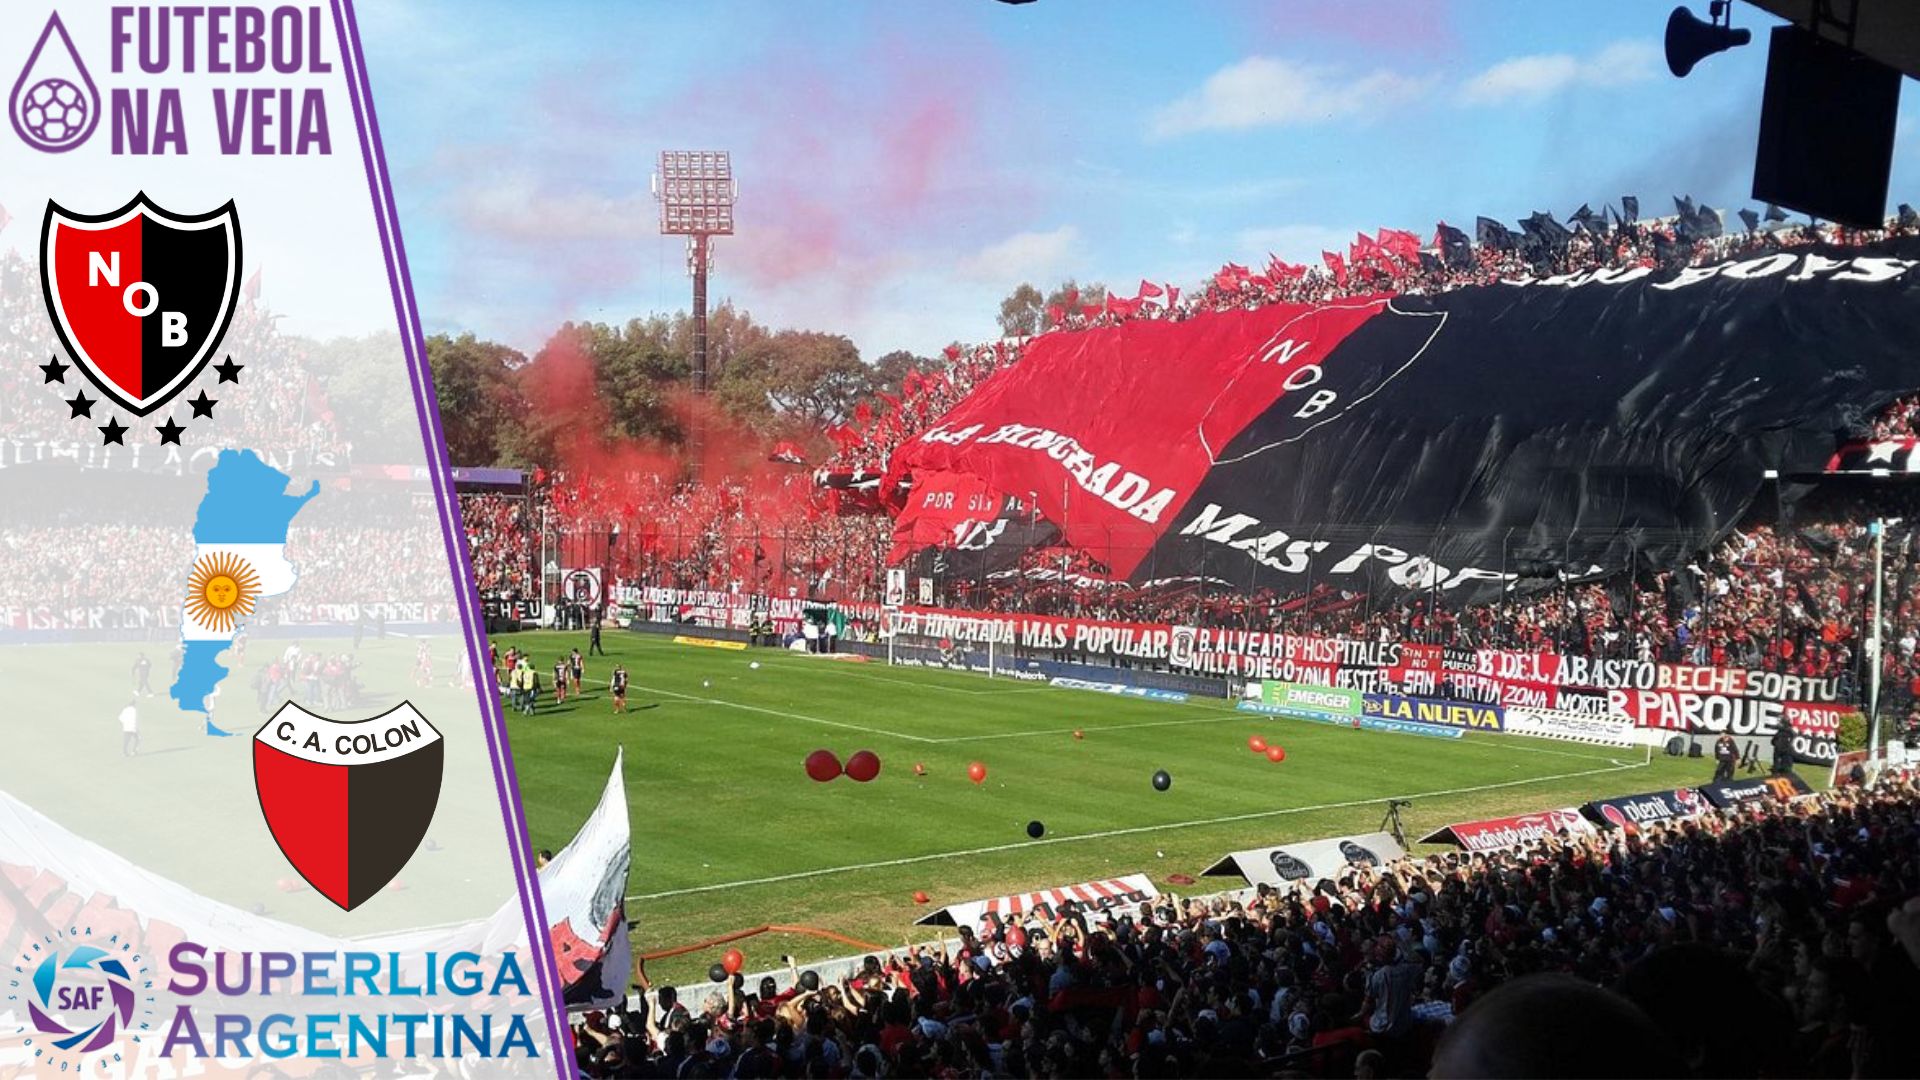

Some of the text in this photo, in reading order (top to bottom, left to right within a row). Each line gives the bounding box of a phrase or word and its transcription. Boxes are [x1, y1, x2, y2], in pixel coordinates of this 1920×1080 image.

[922, 490, 954, 511] POR
[1180, 503, 1330, 573] MAS
[924, 613, 1015, 644] HINCHADA
[1021, 620, 1067, 649] MAS
[1073, 624, 1168, 659] POPULAR
[1215, 630, 1283, 658] ALVEAR
[1303, 637, 1402, 667] HOSPITALES
[1402, 648, 1422, 658] SIN
[1411, 658, 1476, 673] NO PUEDO
[1192, 652, 1295, 681] VILLA DIEGO
[1296, 665, 1378, 694] ZONA OESTE
[1499, 653, 1550, 684] DEL
[1550, 655, 1655, 690] ABASTO
[1403, 669, 1436, 696] SAN
[1288, 688, 1351, 709] EMERGER
[1503, 684, 1608, 715] ZONA NORTE
[1382, 698, 1413, 719] LA
[1418, 701, 1500, 730] NUEVA
[1637, 690, 1784, 736] PARQUE
[1788, 707, 1840, 729] PASIO
[1792, 735, 1837, 760] OLOS
[1720, 785, 1768, 800] Sport
